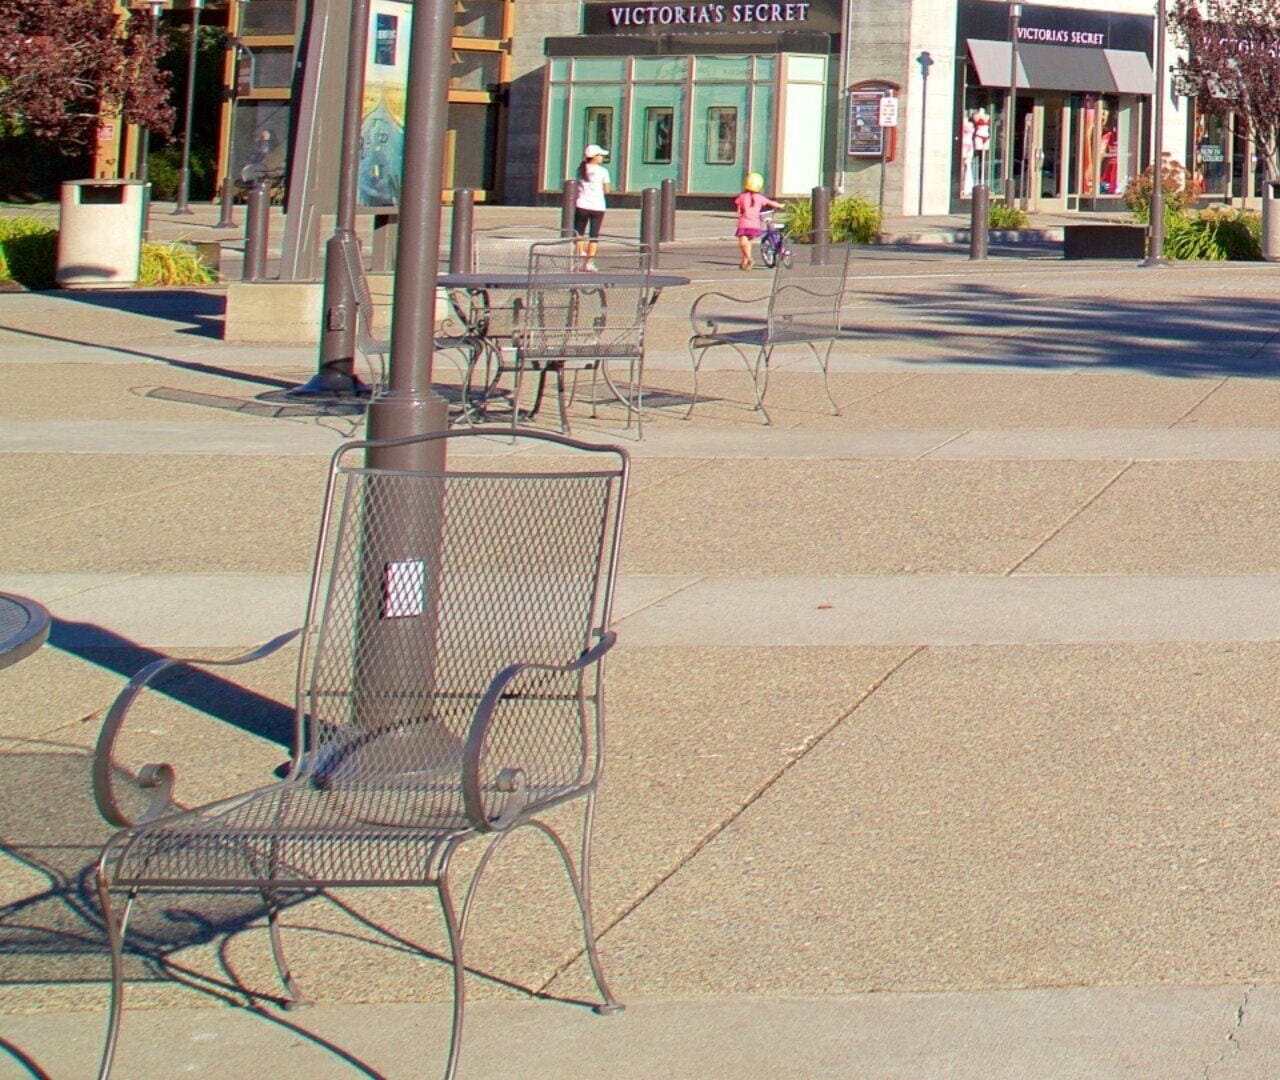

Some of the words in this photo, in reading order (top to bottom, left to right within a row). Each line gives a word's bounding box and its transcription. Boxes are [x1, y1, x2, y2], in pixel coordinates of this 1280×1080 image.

[611, 4, 724, 25] VICTORIA'S
[732, 3, 810, 22] SECRET
[1017, 27, 1068, 42] VICTORIA'S
[1071, 31, 1104, 45] SECRET
